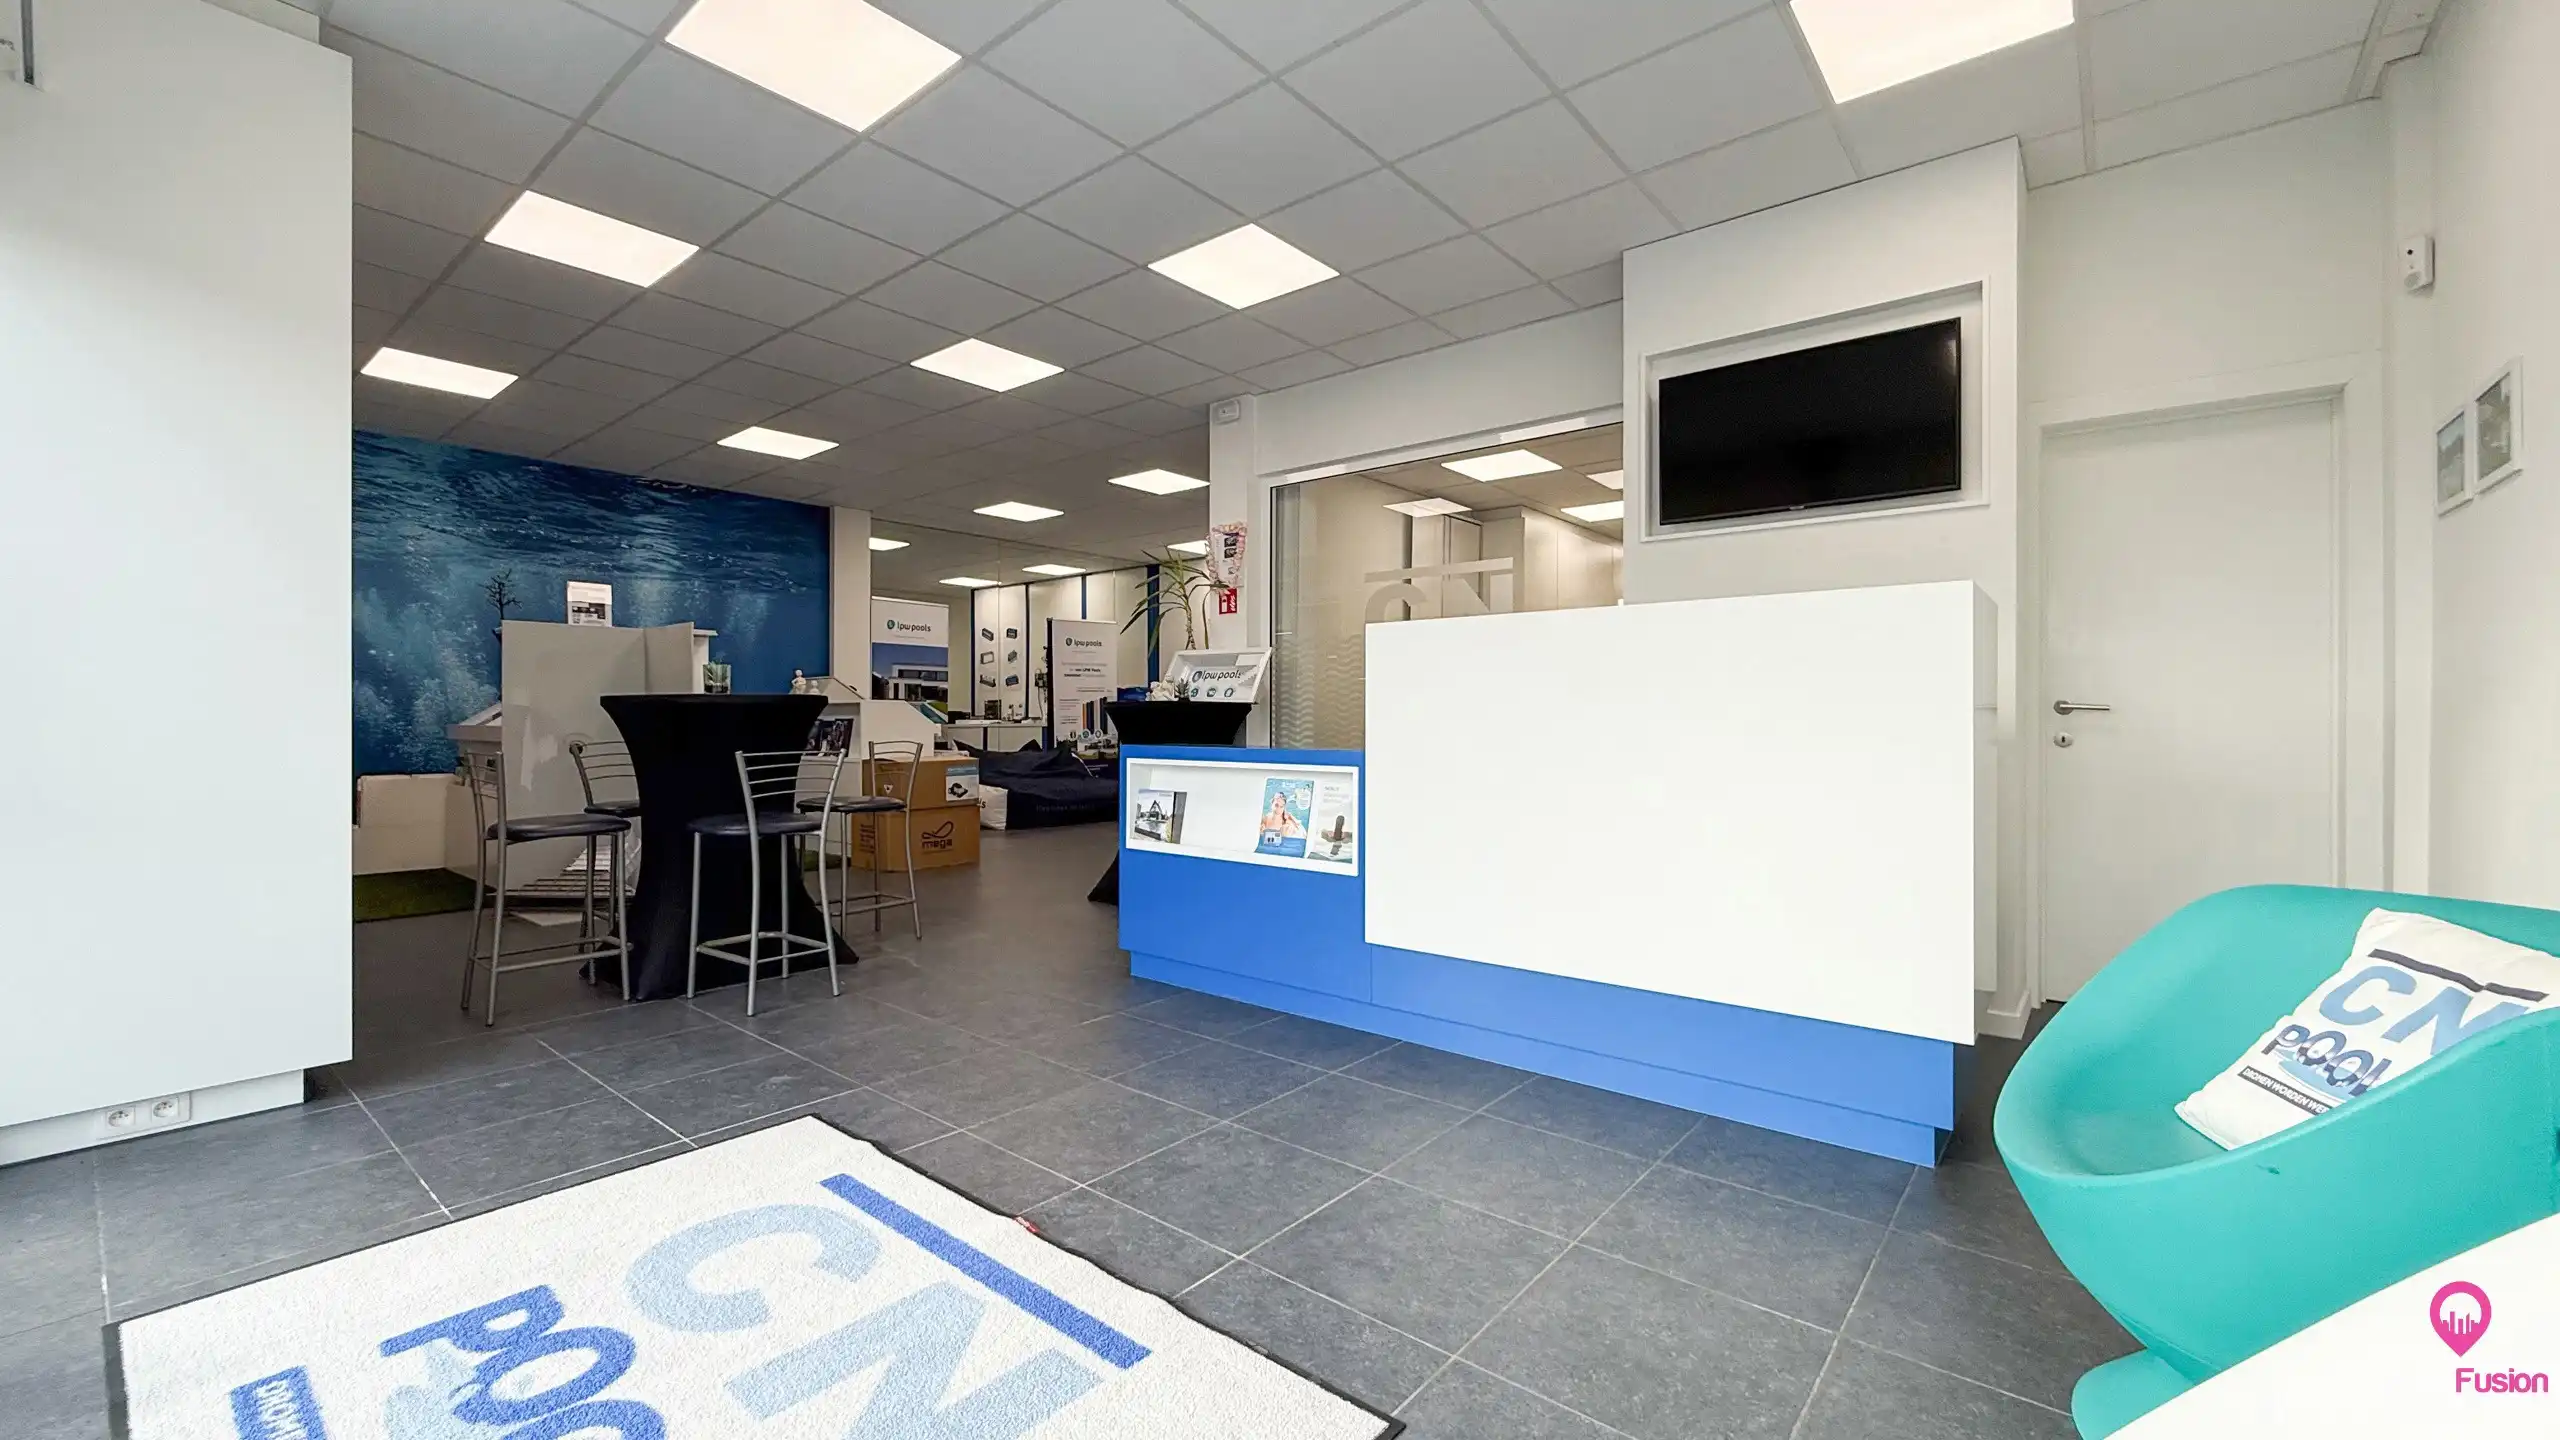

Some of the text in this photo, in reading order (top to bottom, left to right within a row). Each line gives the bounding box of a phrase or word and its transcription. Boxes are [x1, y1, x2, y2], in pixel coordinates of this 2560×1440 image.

[911, 624, 931, 632] pools
[2319, 965, 2530, 1055] CN
[2242, 1067, 2274, 1088] DROMEN
[2272, 1081, 2311, 1106] WORDEN
[624, 1204, 1104, 1440] CN
